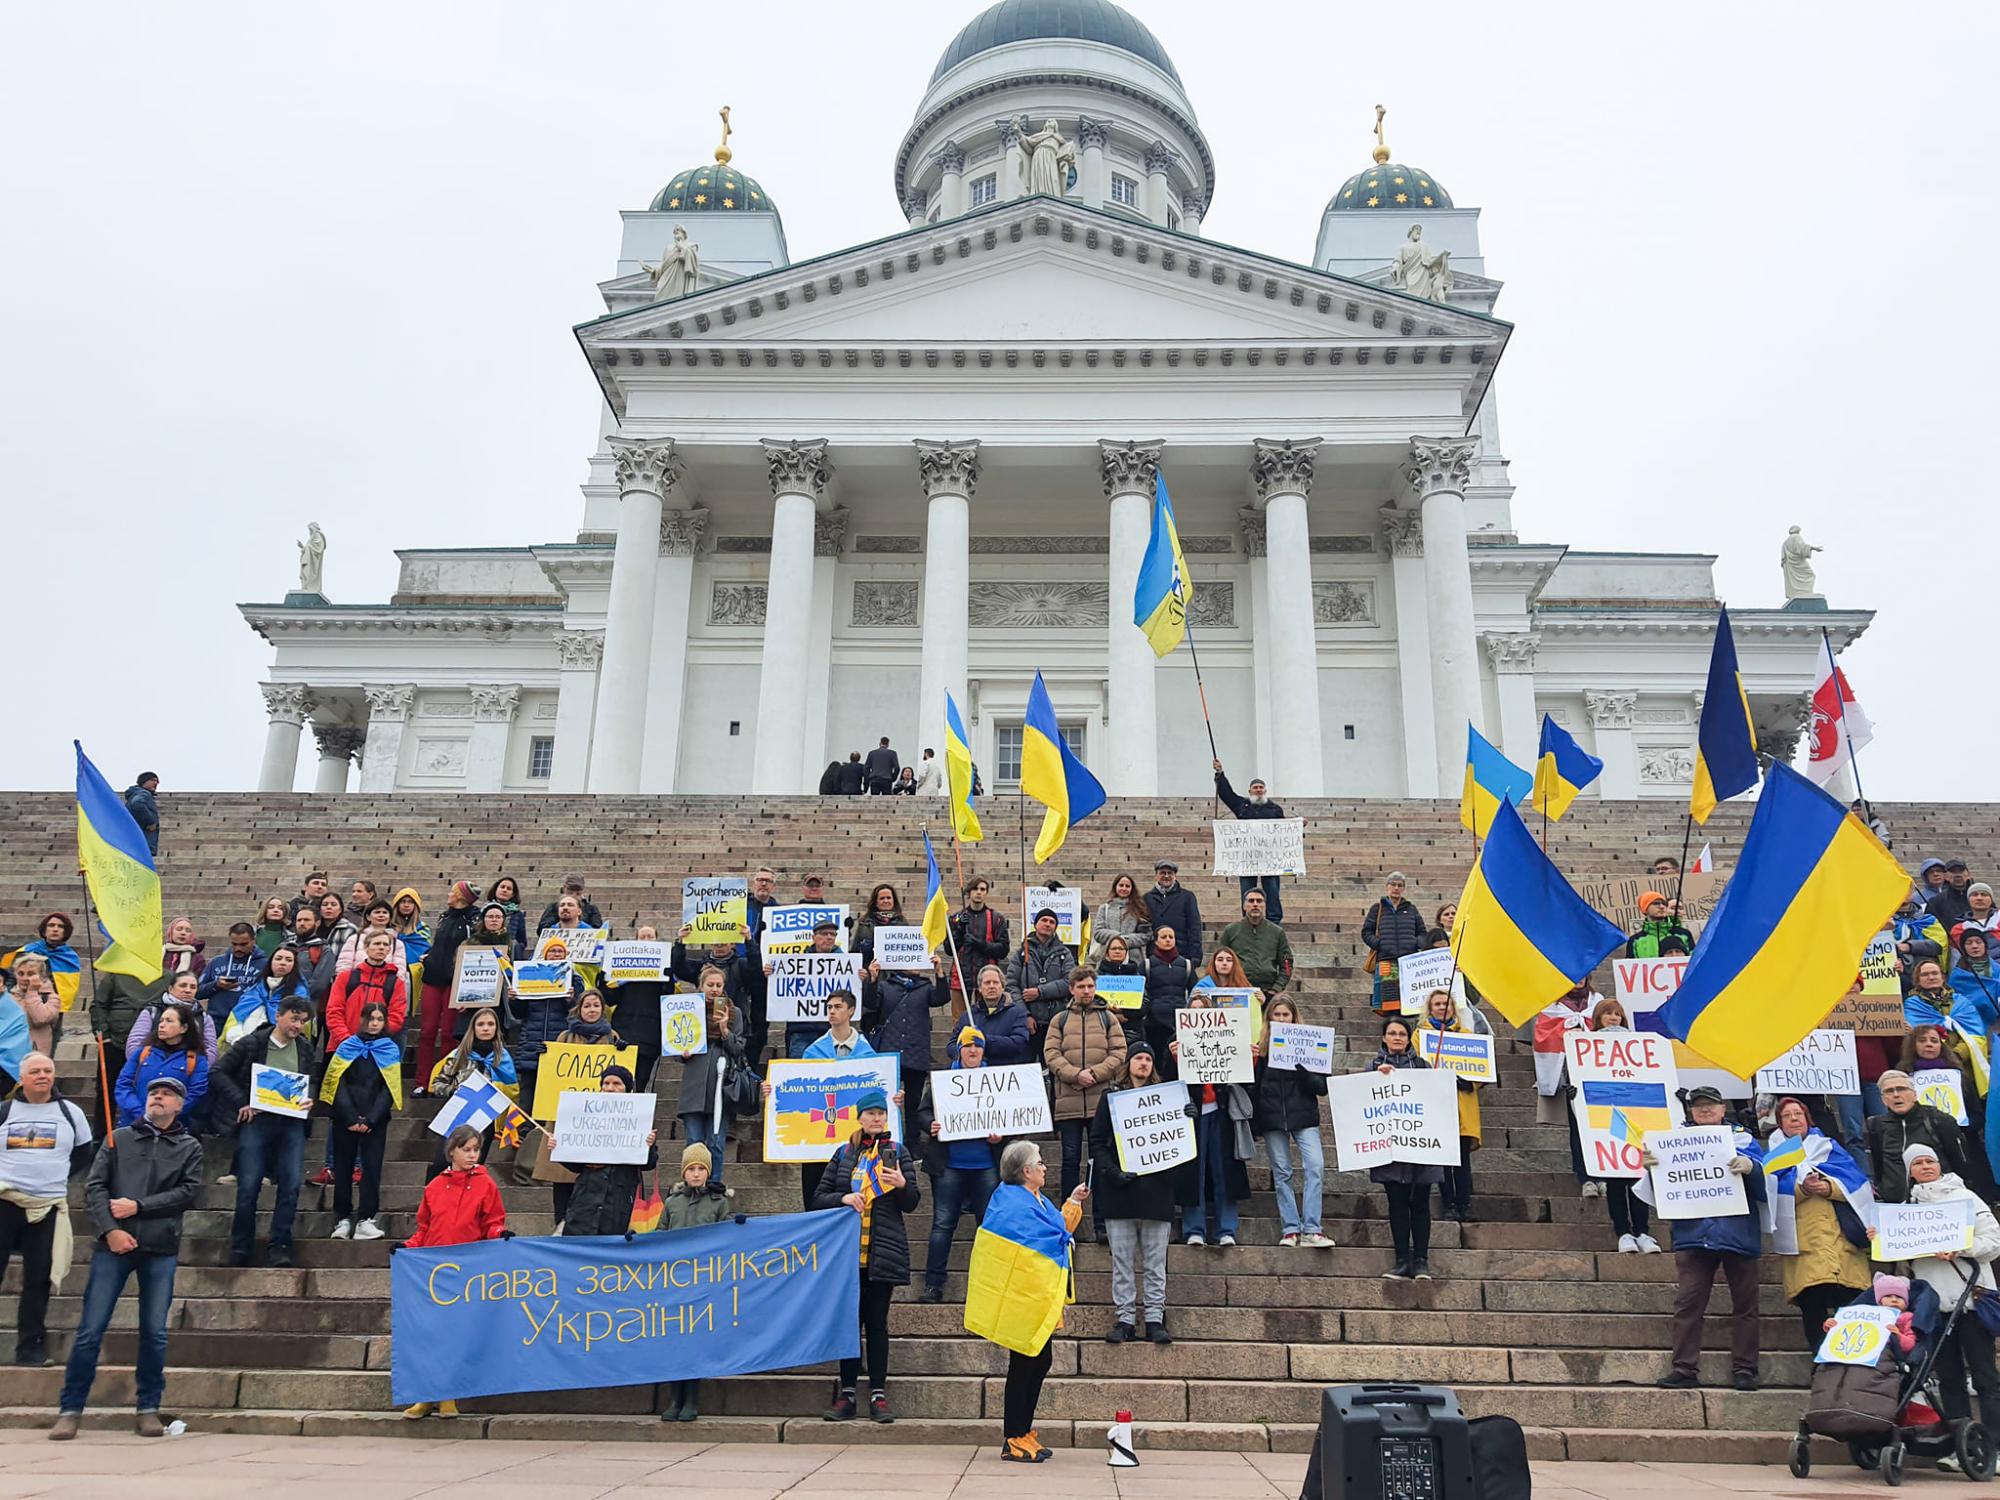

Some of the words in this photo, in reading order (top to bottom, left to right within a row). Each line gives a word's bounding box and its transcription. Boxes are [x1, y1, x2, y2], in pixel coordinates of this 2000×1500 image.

[685, 881, 747, 901] Superheroes
[696, 901, 728, 914] LIVE
[696, 916, 737, 931] Ukraine
[613, 946, 661, 955] Luottakaa
[884, 943, 924, 951] DEFENDS
[612, 959, 660, 967] UKRAINAN
[885, 955, 923, 963] EUROPE
[1406, 955, 1452, 970] UKRAINIAN
[464, 969, 497, 977] VOITTO
[1415, 967, 1440, 978] ARMY
[1618, 963, 1688, 993] VICT
[1411, 976, 1453, 992] SHIELD
[667, 1001, 696, 1011] СЛАВА
[797, 999, 828, 1017] NYT
[1850, 1000, 1902, 1014] Збройним
[1179, 1012, 1227, 1030] RUSSIA
[1857, 1015, 1903, 1032] України
[1282, 1026, 1322, 1039] UKRAINAN
[1287, 1037, 1315, 1047] VOITTO
[1443, 1043, 1467, 1052] stand
[1467, 1045, 1486, 1054] with
[1294, 1047, 1306, 1055] ON
[1575, 1038, 1660, 1068] PEACE
[1187, 1055, 1232, 1070] murder
[1790, 1055, 1815, 1066] ON
[1196, 1070, 1232, 1083] terror
[1611, 1069, 1635, 1078] FOR
[1916, 1073, 1950, 1086] СЛАВА
[780, 1082, 804, 1093] SLAVA
[951, 1071, 1020, 1097] SLAVA
[1372, 1084, 1411, 1101] HELP
[584, 1099, 635, 1114] KUNNIA
[974, 1095, 995, 1109] TO
[1137, 1094, 1162, 1109] AIR
[1363, 1102, 1424, 1119] UKRAINE
[572, 1116, 639, 1131] UKRAINAN
[944, 1109, 1007, 1134] UKRAINIAN
[1012, 1106, 1043, 1128] ARMY
[1123, 1109, 1183, 1130] DEFENSE
[1367, 1122, 1386, 1136] TO
[1388, 1118, 1423, 1132] STOP
[1127, 1135, 1146, 1149] TO
[1149, 1127, 1186, 1145] SAVE
[1658, 1135, 1722, 1150] UKRAINIAN
[1140, 1147, 1180, 1166] LIVES
[1671, 1151, 1706, 1164] ARMY
[1667, 1166, 1725, 1183] SHIELD
[1666, 1191, 1682, 1201] OF
[1685, 1186, 1734, 1200] EUROPE
[1887, 1222, 1960, 1238] UKRAINAN
[429, 1262, 558, 1306] Слава
[576, 1242, 819, 1296] захисникам
[1842, 1310, 1880, 1321] СЛАВА
[520, 1299, 714, 1352] України
